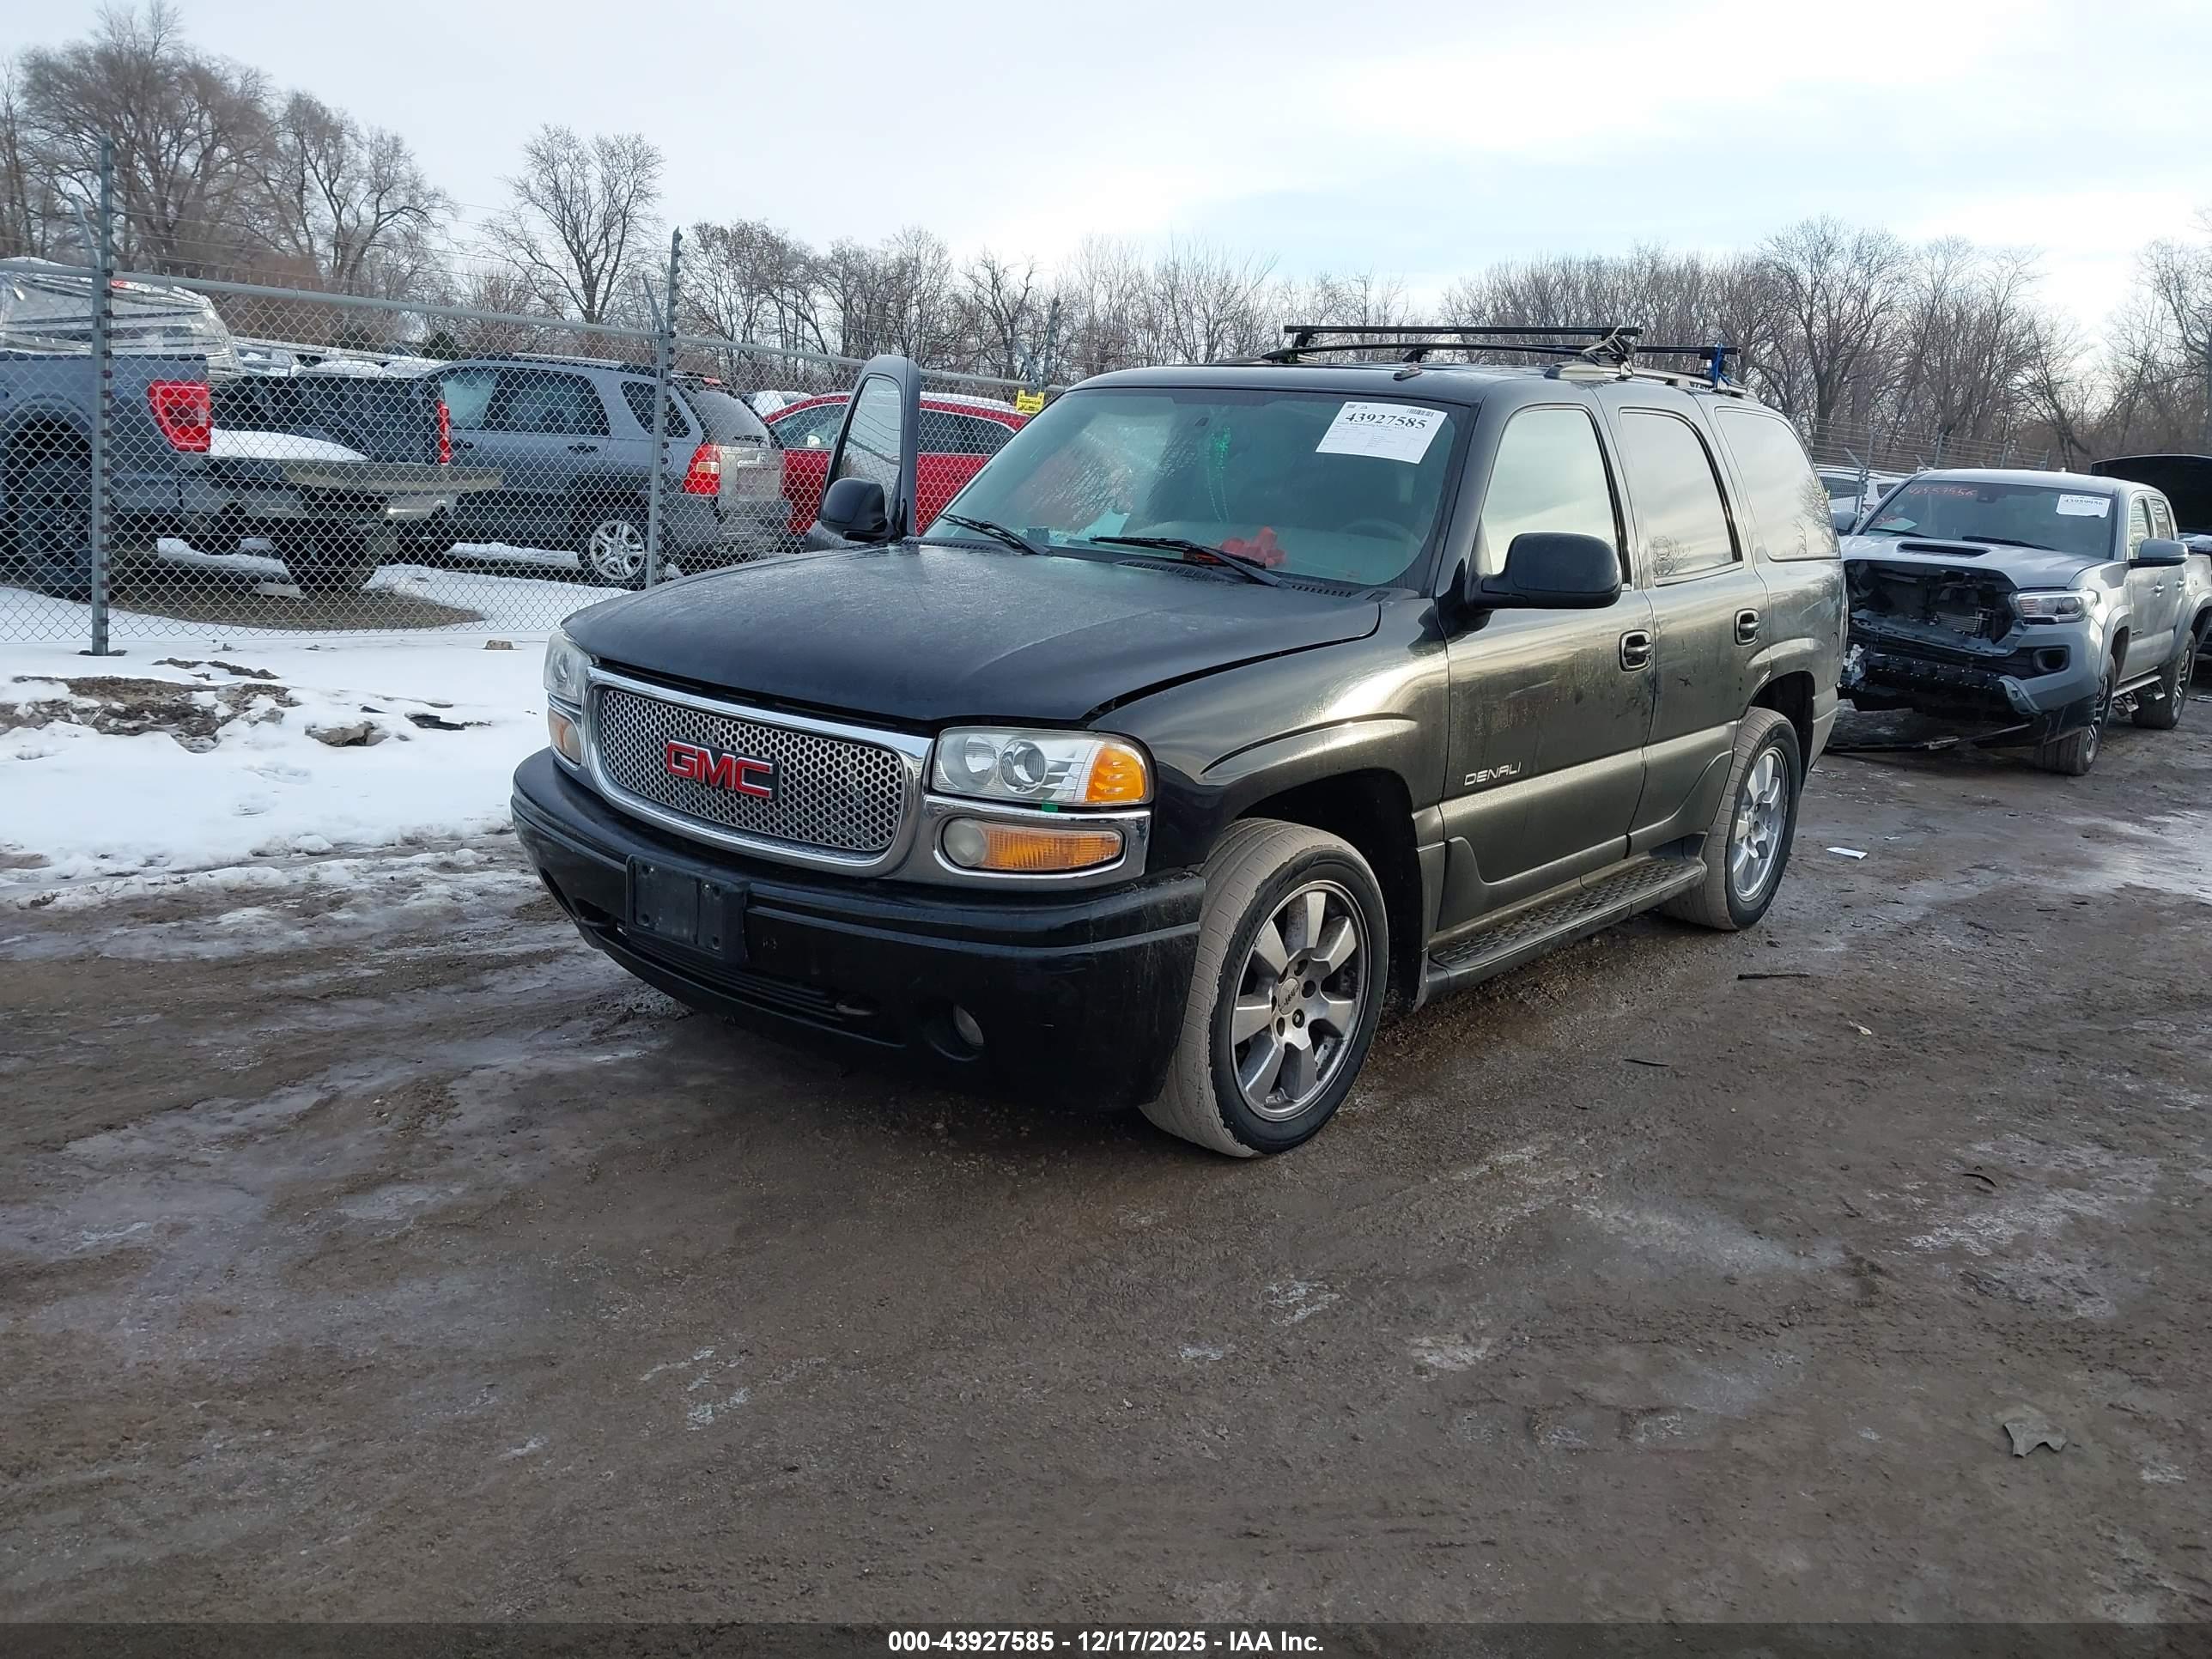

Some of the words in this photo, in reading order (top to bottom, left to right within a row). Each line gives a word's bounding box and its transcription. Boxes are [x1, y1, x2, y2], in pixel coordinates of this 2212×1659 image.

[1346, 413, 1427, 429] 43927585
[666, 740, 773, 799] GMC
[1464, 762, 1521, 786] DENALI
